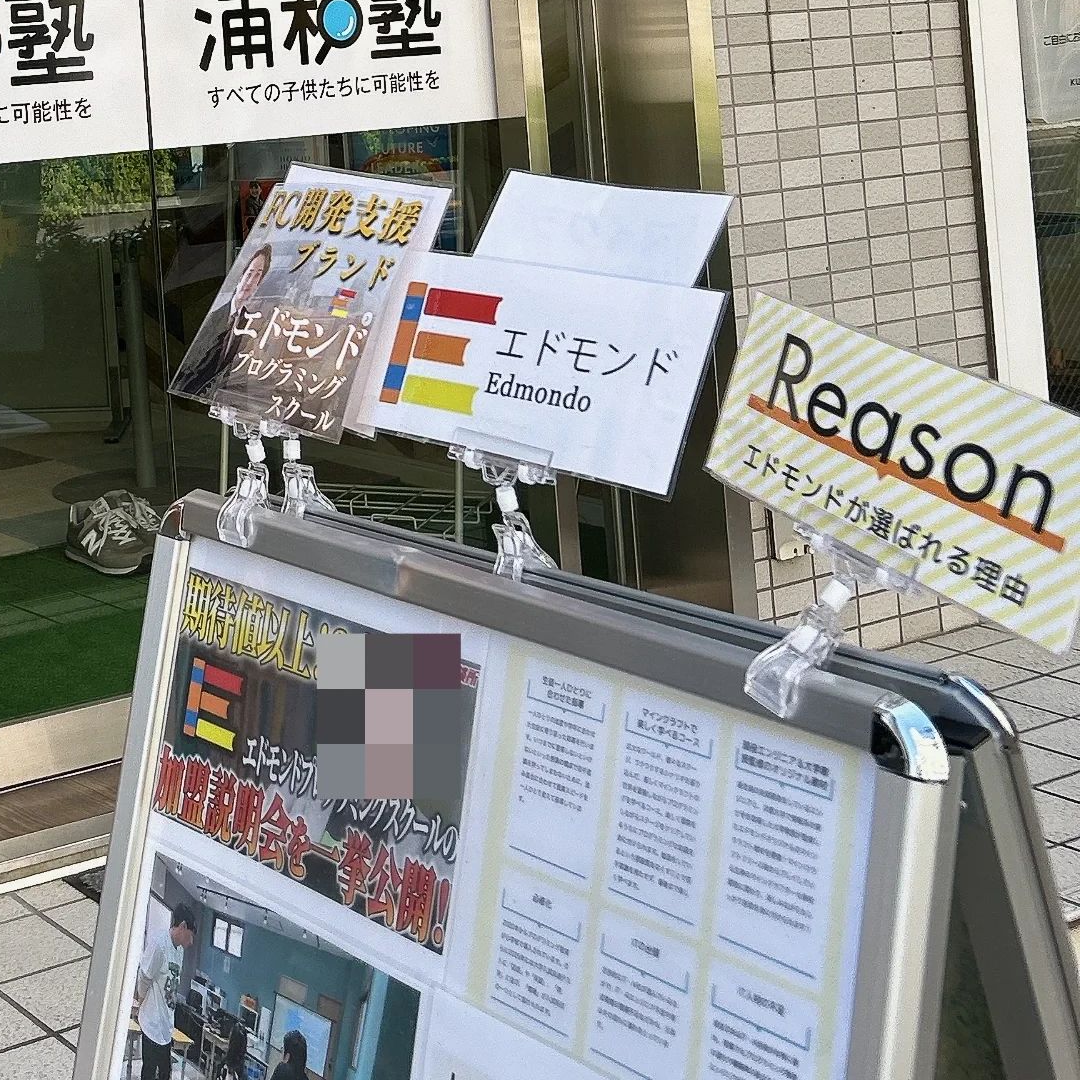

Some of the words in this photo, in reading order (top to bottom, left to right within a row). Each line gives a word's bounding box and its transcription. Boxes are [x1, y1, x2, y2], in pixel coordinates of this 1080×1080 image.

[206, 69, 440, 109] すべての子供たちに可能性を
[261, 187, 424, 246] FC開発支援
[290, 241, 395, 290] ブランド
[233, 307, 370, 372] エドモンド
[495, 328, 679, 387] エドモンド
[233, 351, 348, 399] プログラミング
[485, 370, 592, 414] Edmondo
[265, 393, 335, 433] スクール
[767, 333, 1054, 533] Reason
[742, 443, 1029, 607] エドモンドが選ばれる理由
